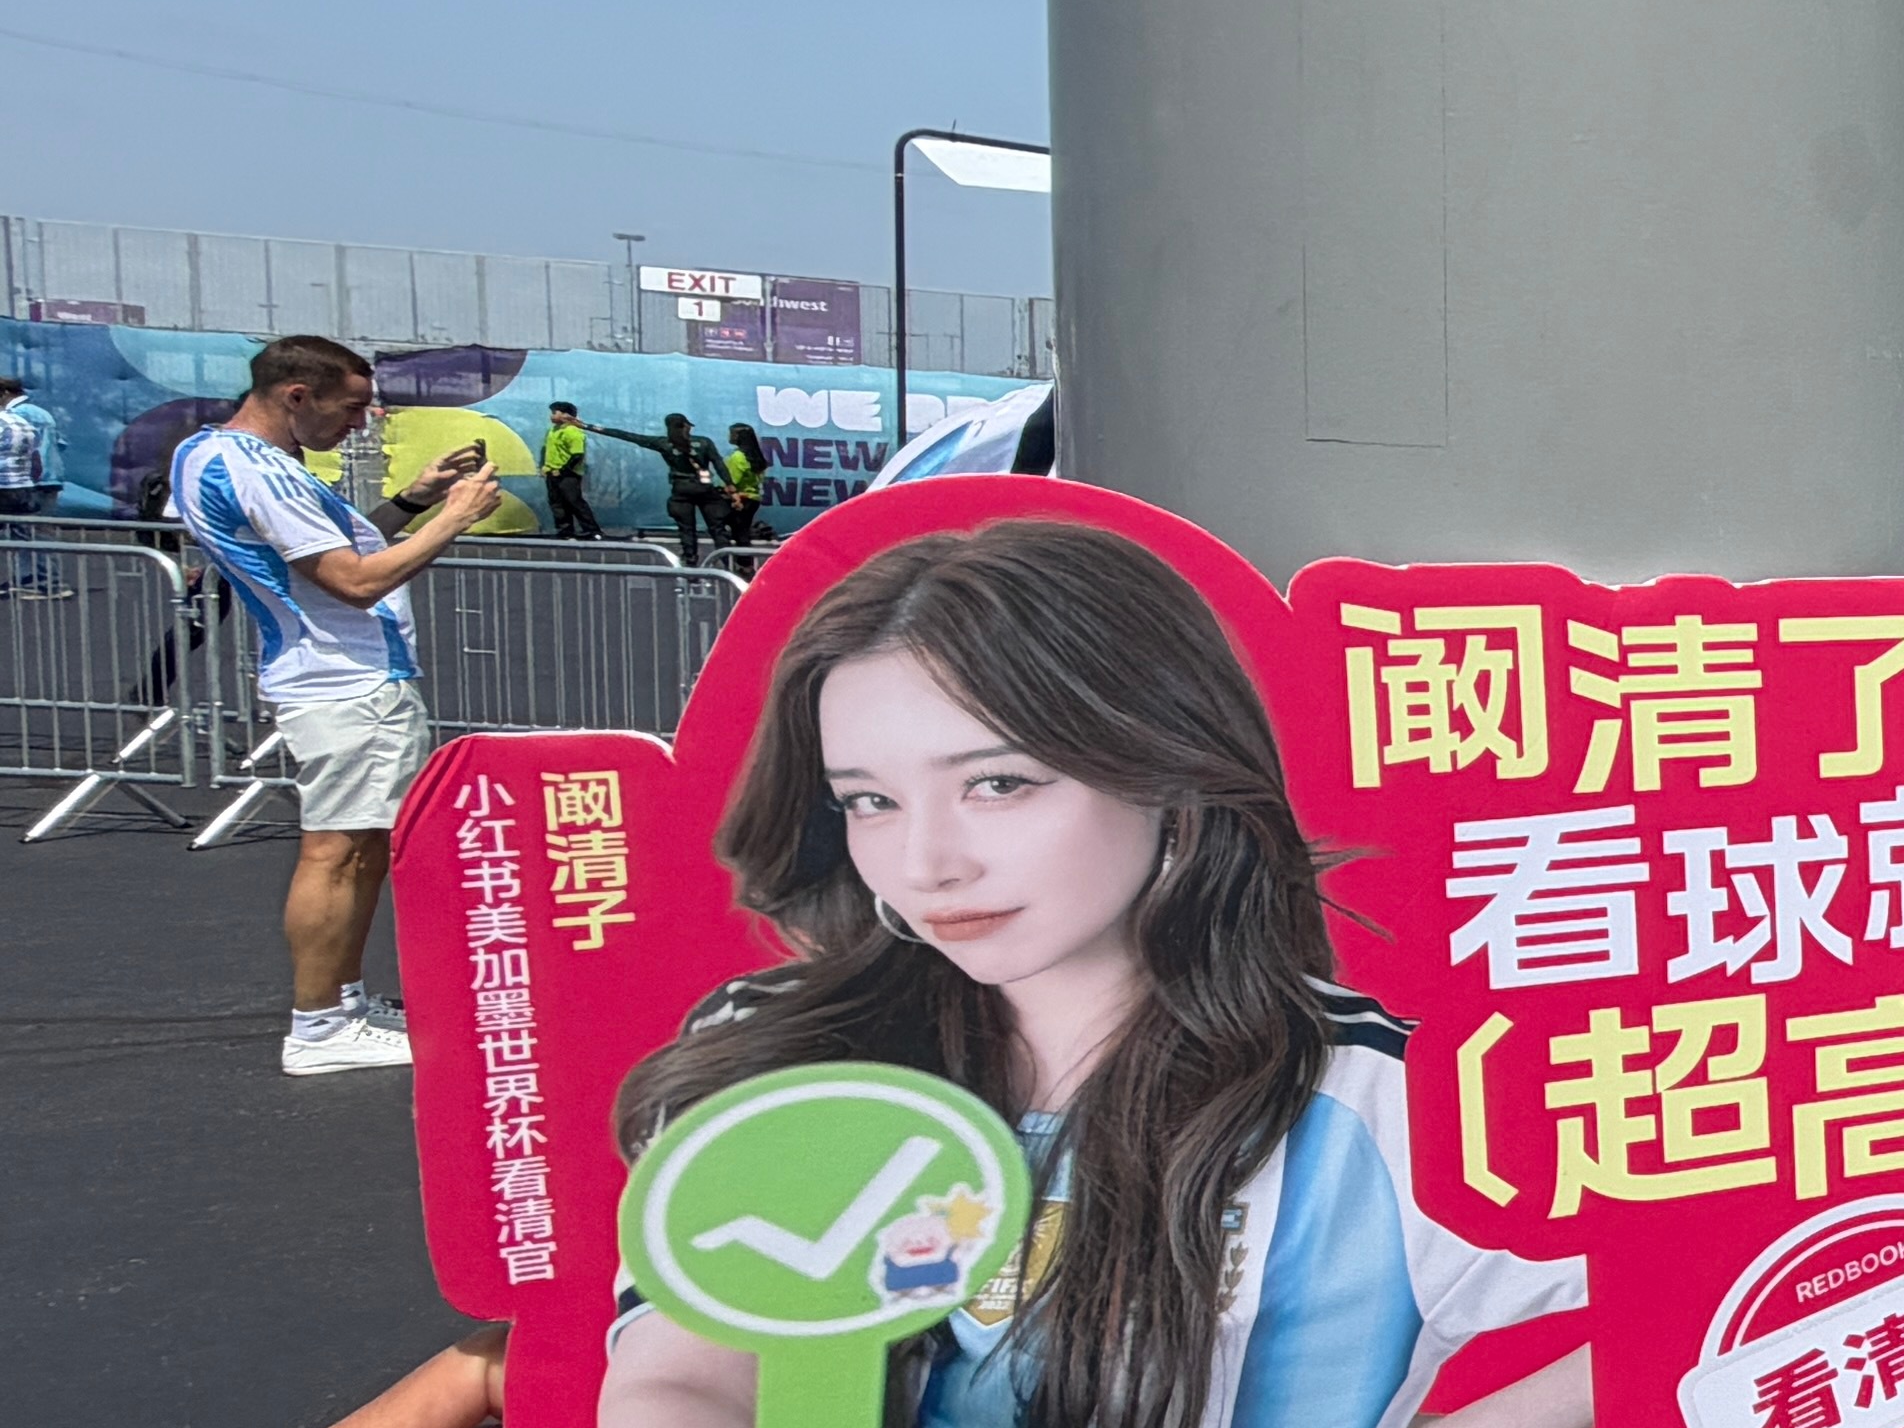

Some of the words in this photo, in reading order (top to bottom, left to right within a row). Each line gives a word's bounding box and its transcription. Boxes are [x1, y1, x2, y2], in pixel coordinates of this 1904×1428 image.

[667, 271, 737, 294] EXIT
[693, 300, 703, 317] 1
[756, 386, 882, 432] WE
[761, 436, 890, 472] NEW
[540, 770, 635, 951] 阚清子
[453, 774, 558, 1286] 小红书美加墨世界杯看清官
